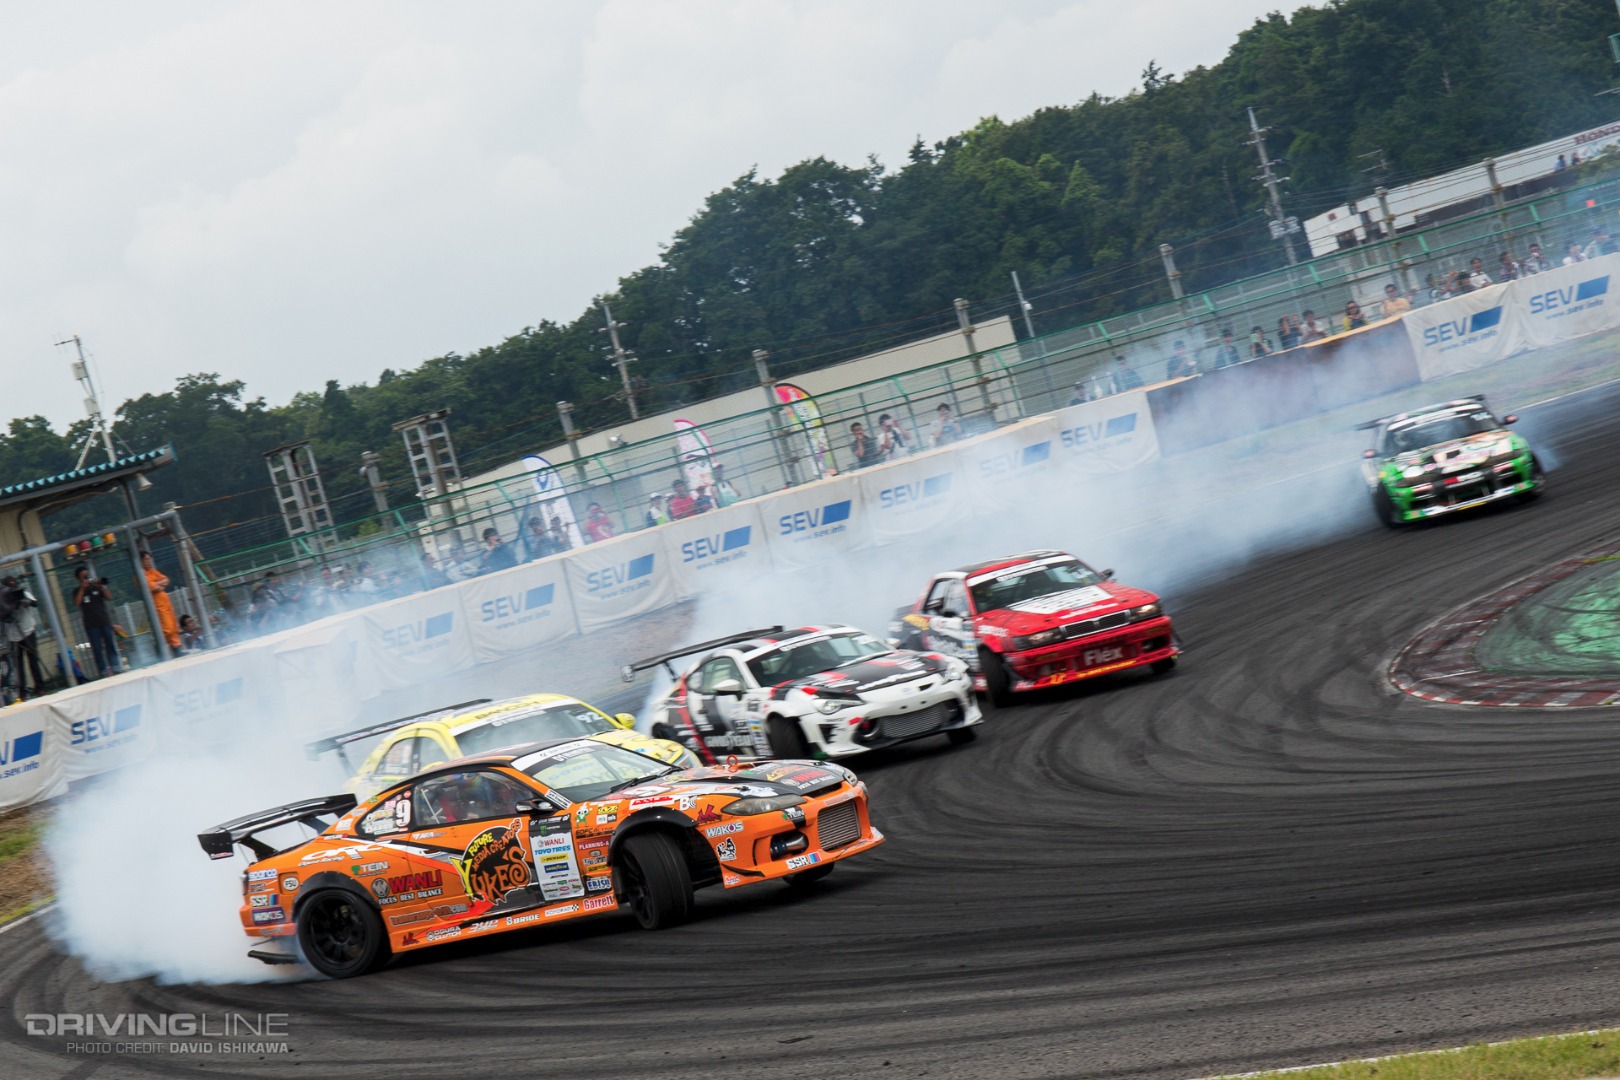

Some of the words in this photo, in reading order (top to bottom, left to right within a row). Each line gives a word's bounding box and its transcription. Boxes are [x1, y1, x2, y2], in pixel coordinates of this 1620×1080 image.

[1529, 286, 1573, 314] SEV
[1424, 318, 1467, 347] SEV
[1061, 422, 1102, 449] SEV
[880, 481, 921, 509] SEV
[779, 508, 819, 535] SEV
[681, 534, 720, 563] SEV
[586, 563, 625, 592] SEV
[481, 592, 522, 623] SEV
[382, 620, 423, 650] SEV
[174, 686, 213, 716] SEV
[71, 713, 110, 745] SEV
[395, 799, 412, 827] 9
[468, 832, 494, 857] FUTURE
[534, 847, 552, 856] TOYO
[552, 844, 571, 853] TIRES
[543, 837, 565, 848] WANLI
[360, 861, 390, 873] TEIN
[472, 845, 491, 872] MEDIA
[389, 869, 443, 894] WANLI
[378, 896, 398, 905] FOCUS
[400, 893, 415, 902] BEST
[418, 888, 443, 899] BALANCE
[583, 895, 615, 910] Garrett
[513, 914, 540, 924] BRIDE
